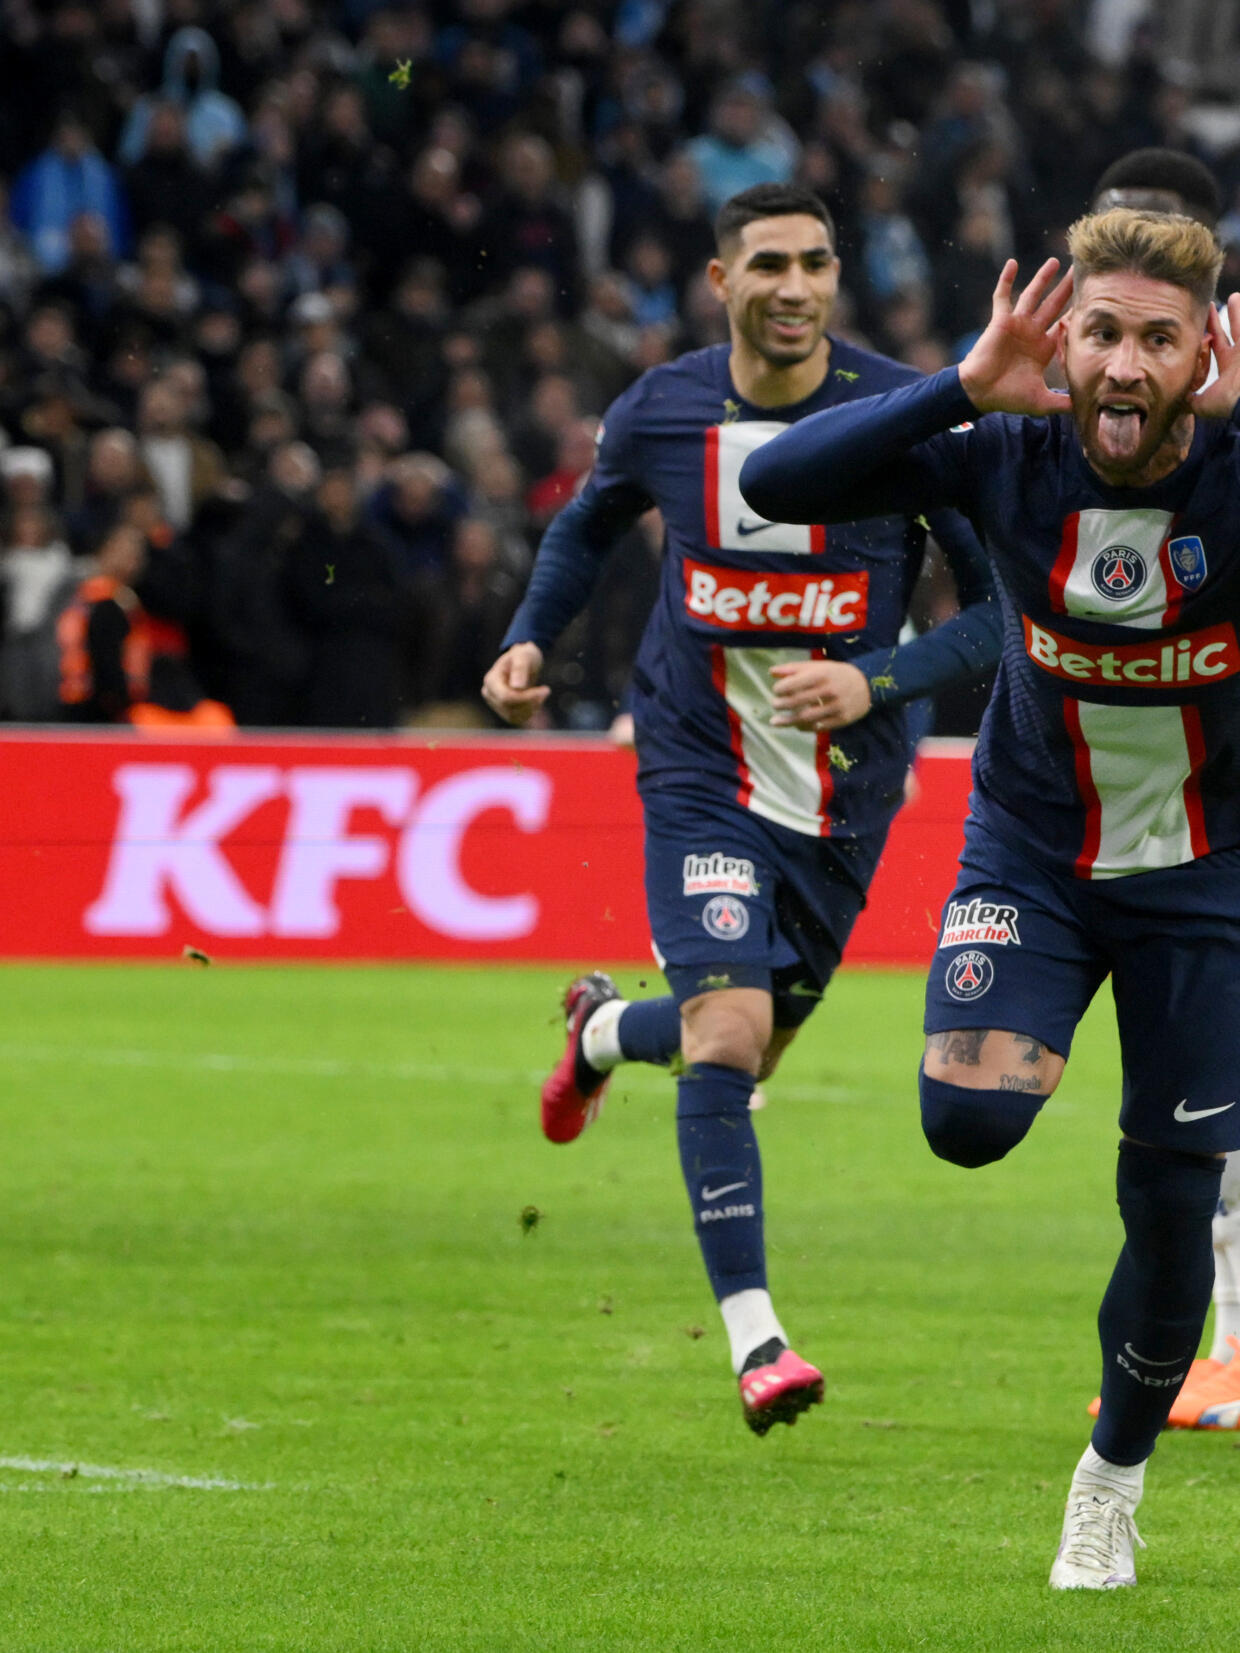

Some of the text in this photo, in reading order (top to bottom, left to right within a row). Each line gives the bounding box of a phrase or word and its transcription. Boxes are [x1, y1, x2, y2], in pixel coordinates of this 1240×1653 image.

[1102, 549, 1138, 565] PARIS
[687, 569, 861, 627] Betclic
[1030, 623, 1229, 682] Betclic
[83, 764, 552, 941] KFC
[954, 954, 986, 967] PARIS
[700, 1204, 755, 1223] PARIS
[1116, 1353, 1184, 1387] PARIS
